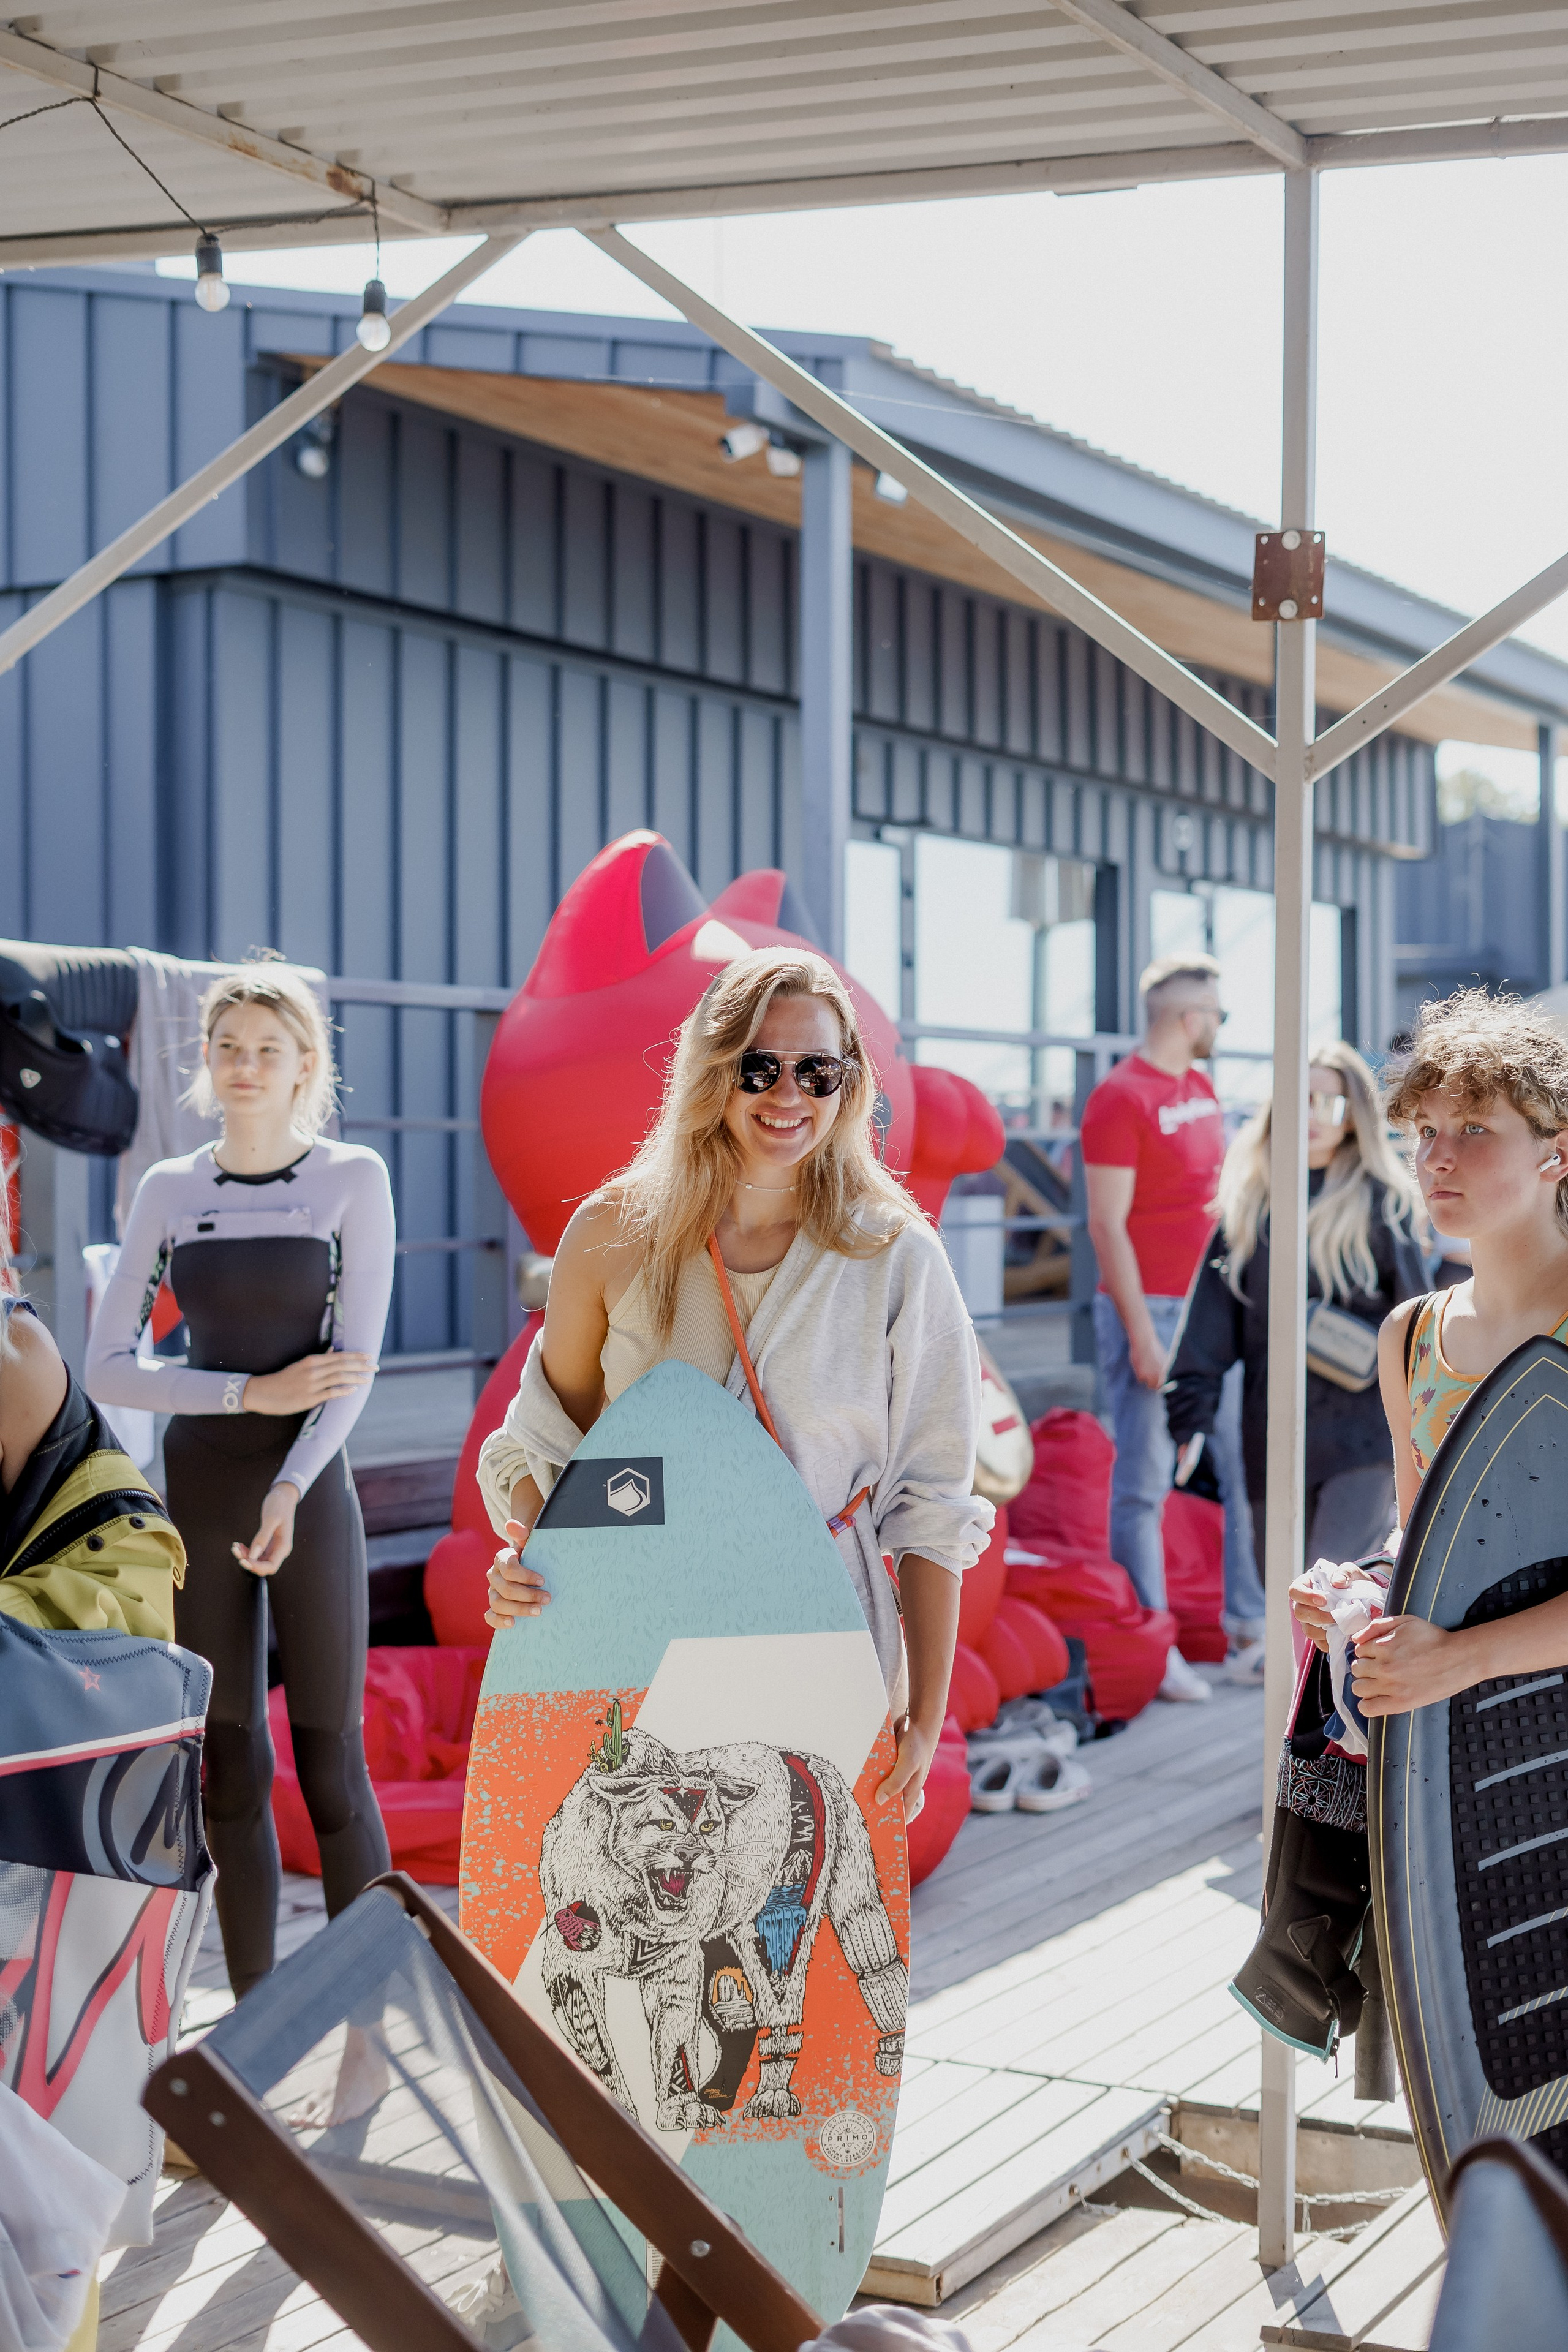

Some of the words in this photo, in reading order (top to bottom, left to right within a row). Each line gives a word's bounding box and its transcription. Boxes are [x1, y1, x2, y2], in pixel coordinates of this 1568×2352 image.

[824, 2114, 846, 2135] LIQUID
[852, 2114, 872, 2133] FORCE
[826, 2147, 839, 2160] BOARD
[862, 2141, 872, 2155] OTHER
[829, 2144, 842, 2157] TOMMY
